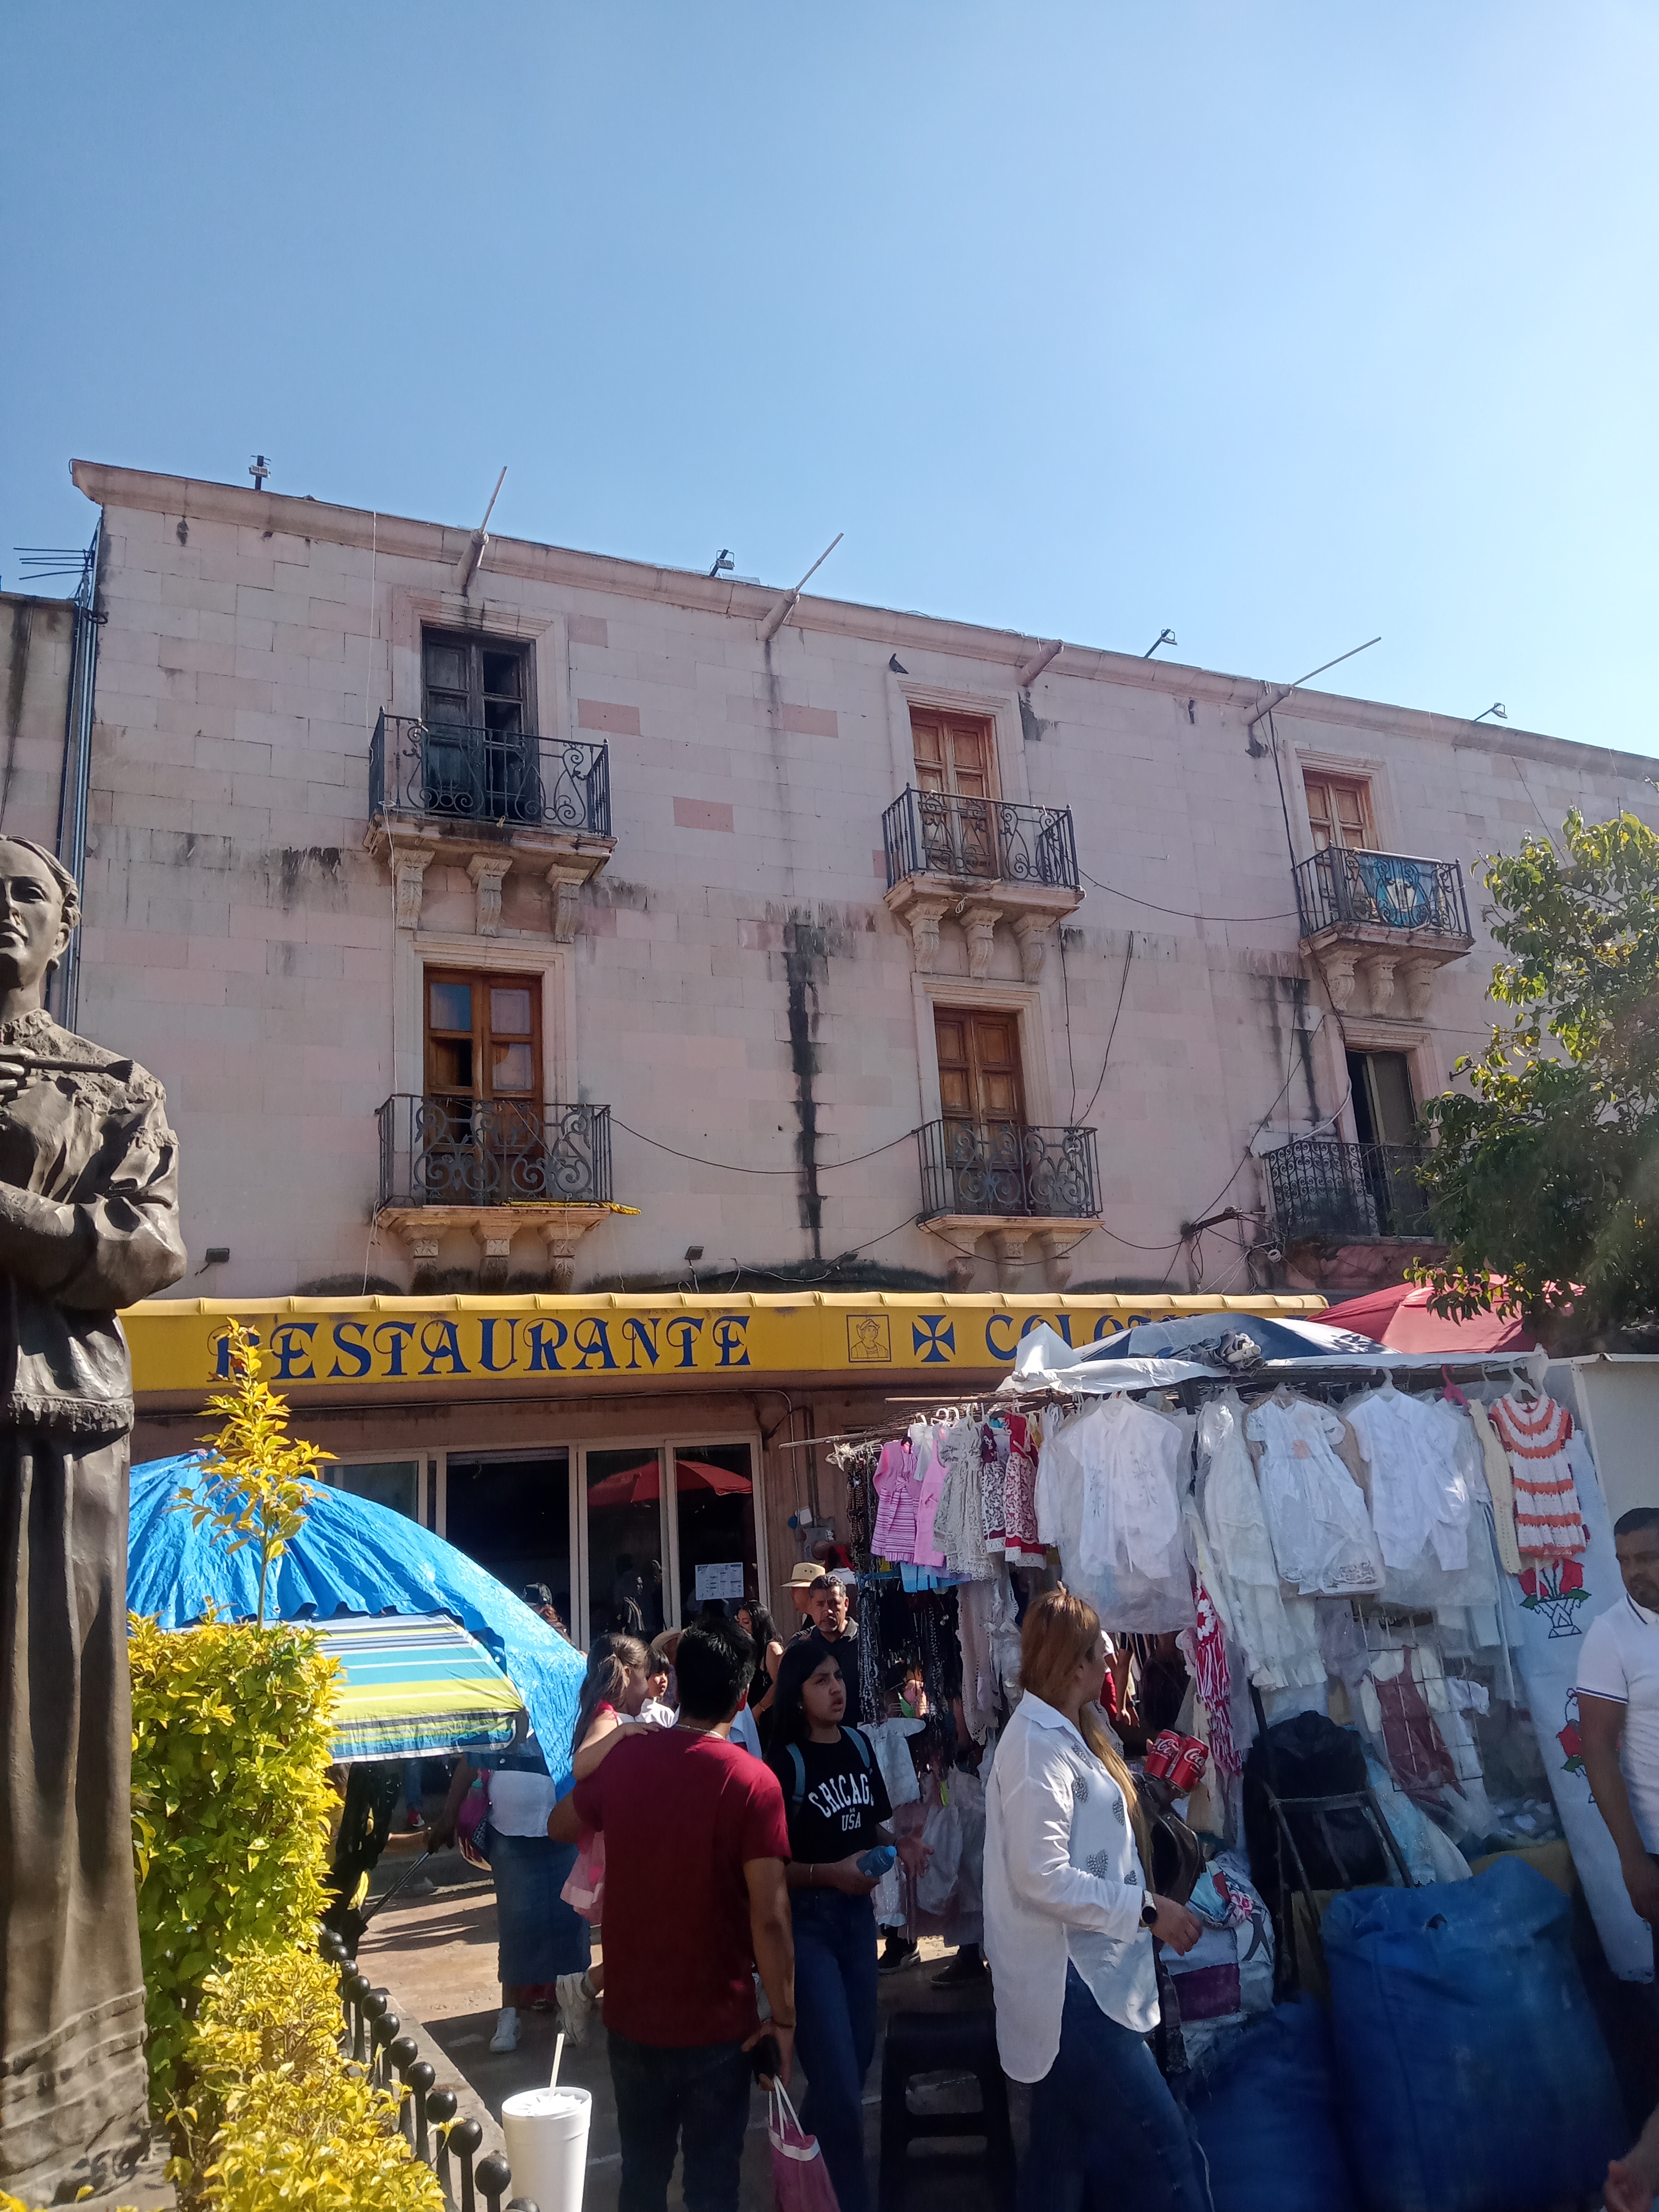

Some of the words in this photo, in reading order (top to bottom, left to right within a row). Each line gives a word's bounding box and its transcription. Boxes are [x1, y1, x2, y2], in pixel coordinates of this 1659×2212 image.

[206, 1316, 752, 1382] RESTAURANTE
[808, 1773, 874, 1819] CHICAG
[841, 1812, 861, 1832] USA
